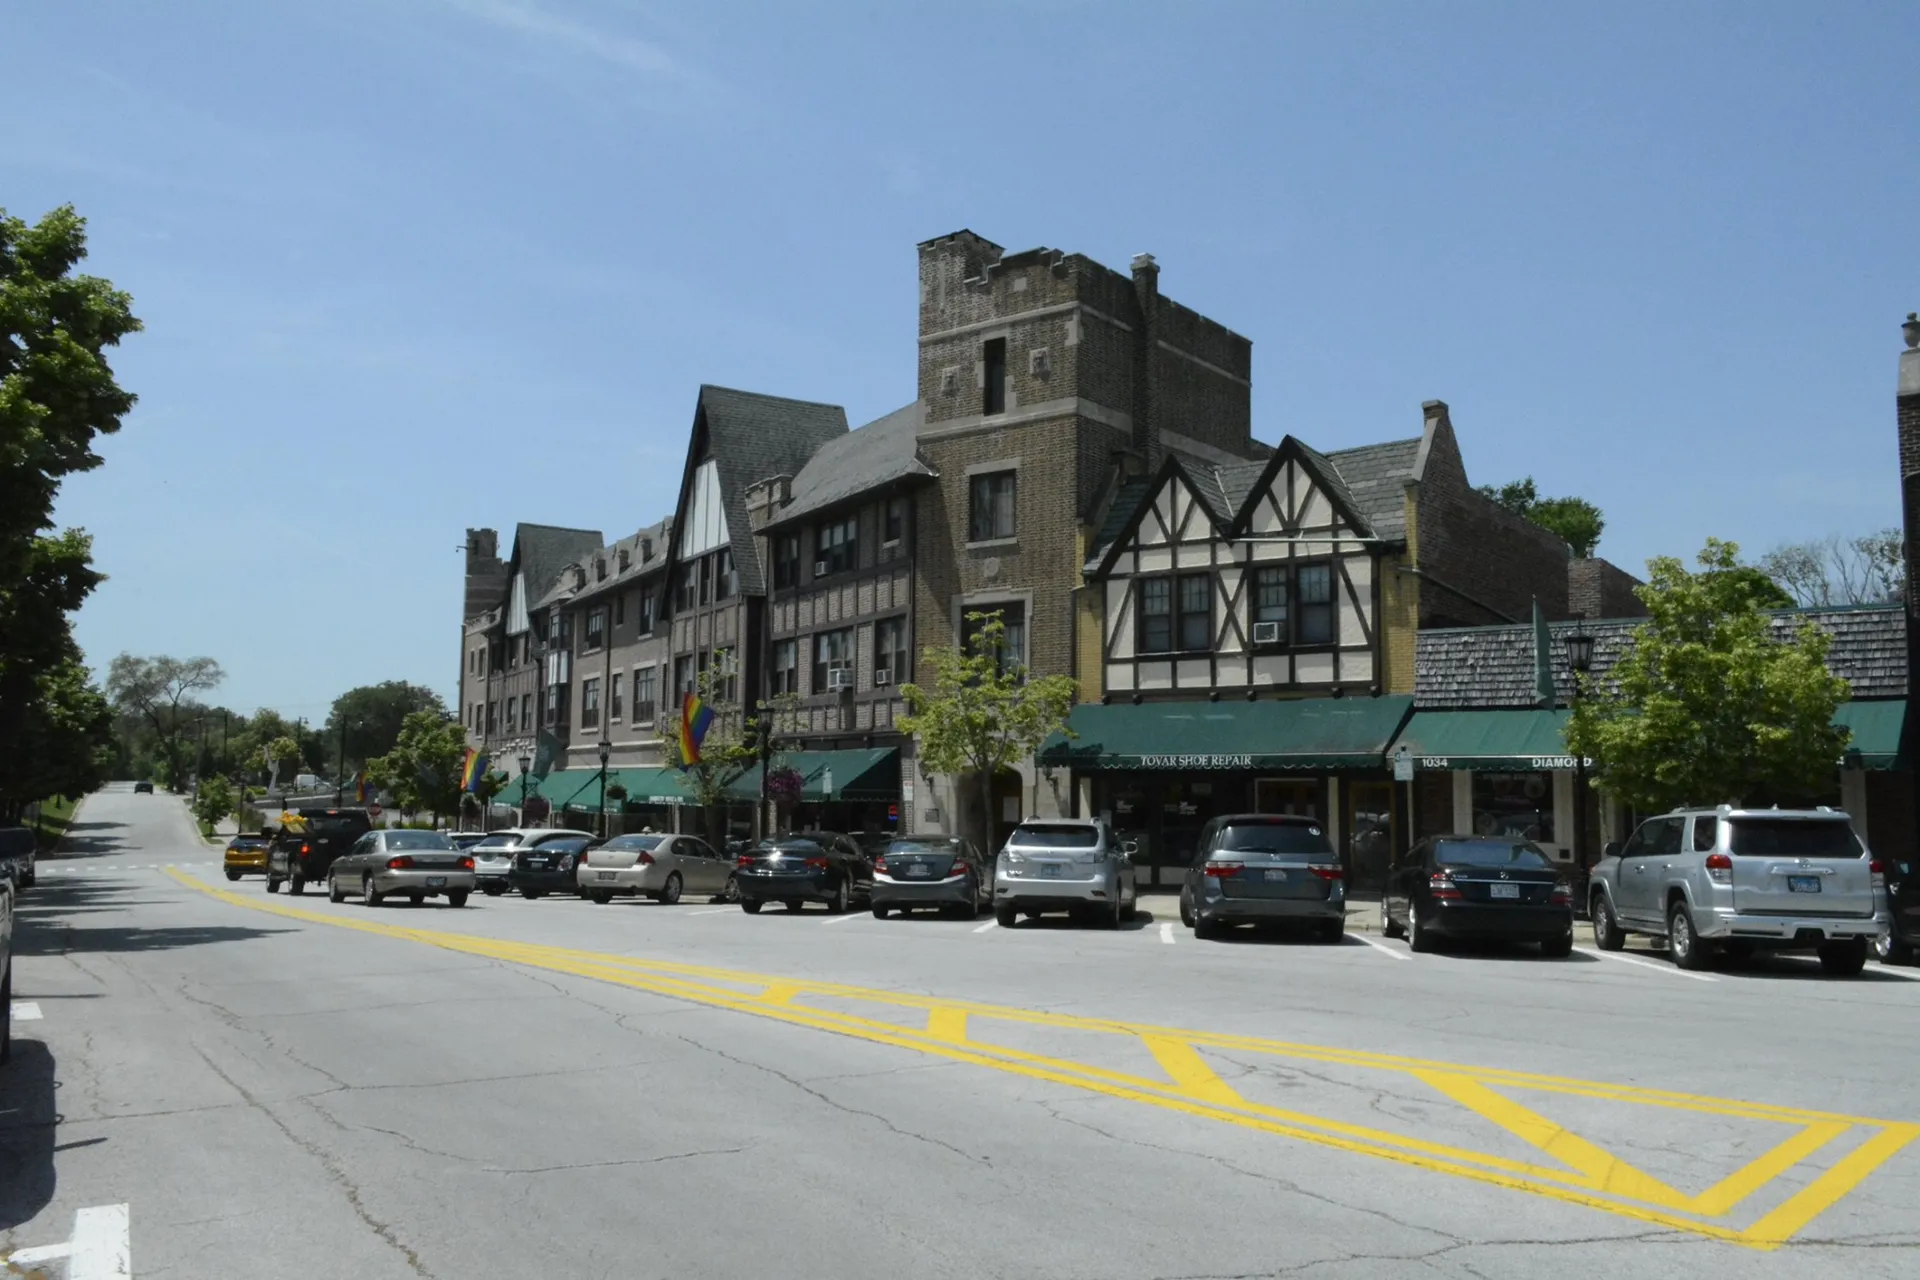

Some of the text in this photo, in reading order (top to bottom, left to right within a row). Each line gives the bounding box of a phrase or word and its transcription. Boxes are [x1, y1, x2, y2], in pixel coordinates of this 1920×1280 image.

[1141, 755, 1252, 766] TOVAR SHOE REPAIR
[1422, 757, 1448, 768] 1034
